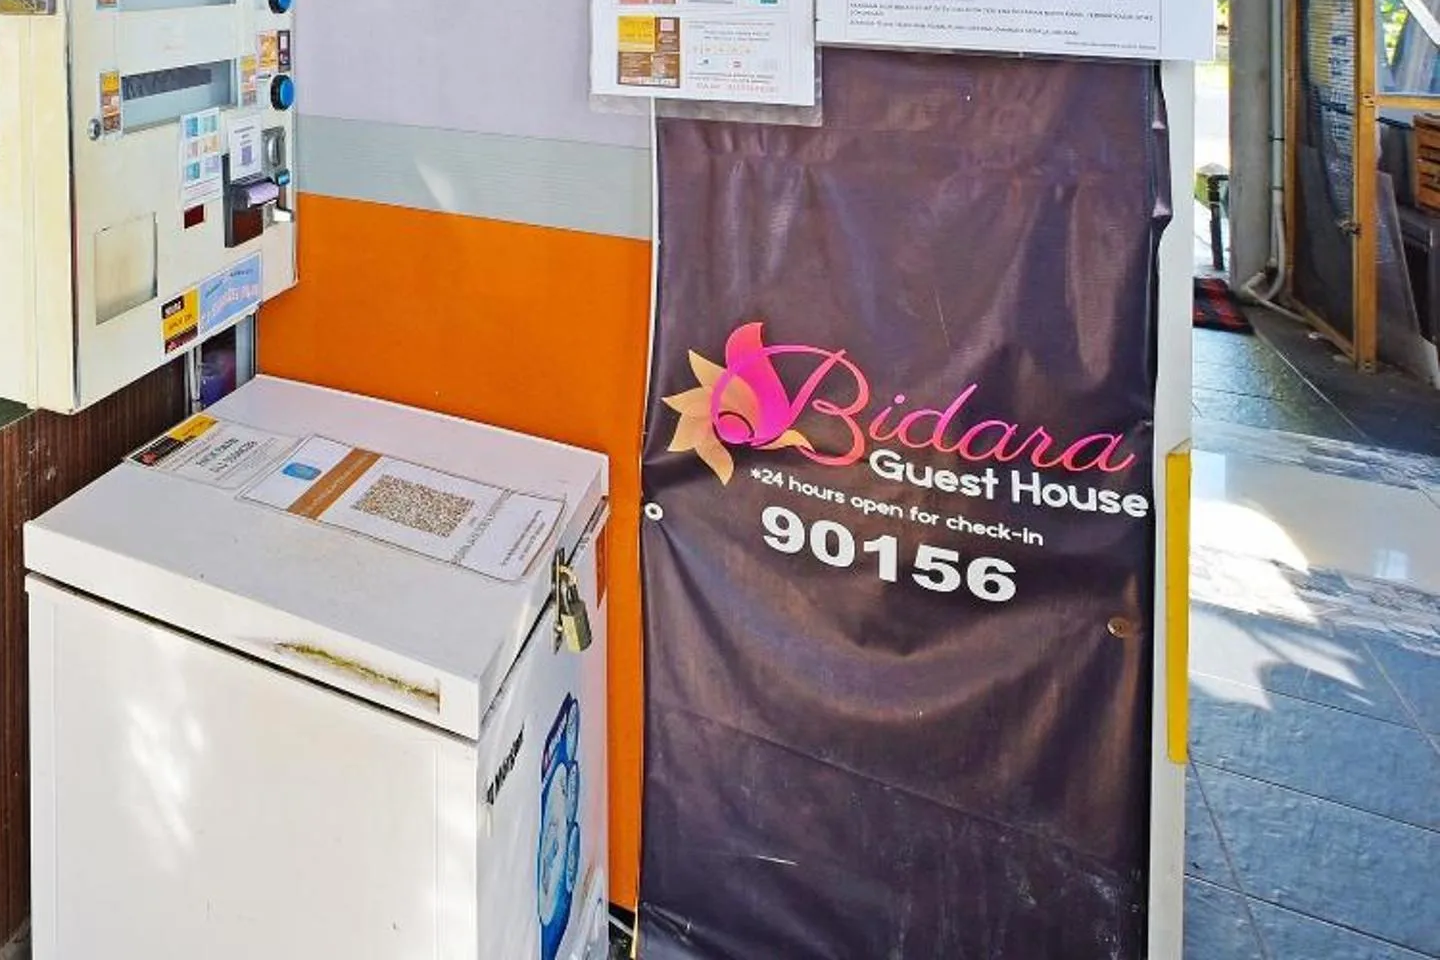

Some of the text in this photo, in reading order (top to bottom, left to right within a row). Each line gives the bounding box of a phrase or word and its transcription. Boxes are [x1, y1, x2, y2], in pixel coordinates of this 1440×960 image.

[712, 344, 1136, 472] Bidara
[787, 471, 846, 506] hours
[850, 497, 905, 523] open
[910, 504, 940, 527] for
[945, 513, 1044, 548] check-in
[868, 448, 1150, 519] Guest House
[761, 505, 1017, 602] 90156
